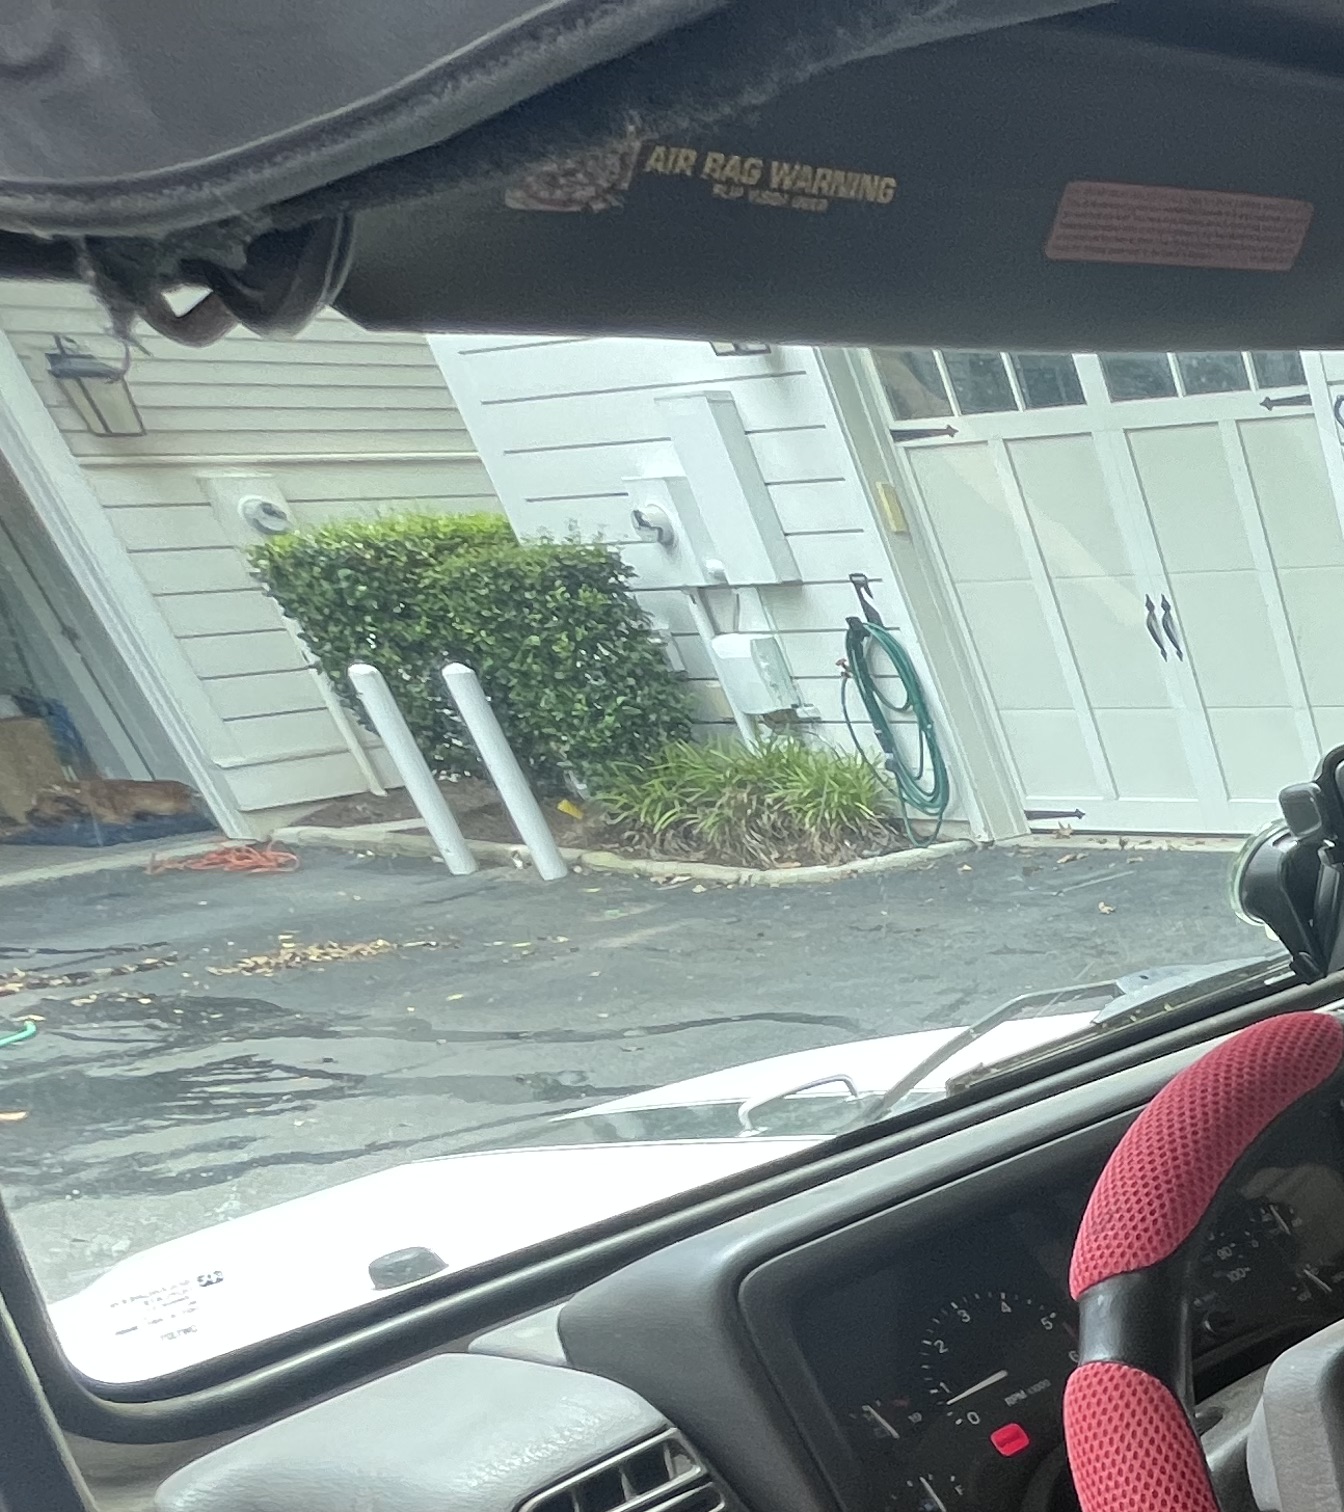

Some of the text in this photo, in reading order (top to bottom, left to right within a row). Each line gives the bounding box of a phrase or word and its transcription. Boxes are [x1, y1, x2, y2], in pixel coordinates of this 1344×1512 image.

[644, 146, 697, 176] AIR
[701, 151, 764, 185] BAG
[770, 160, 897, 204] WARNING
[1001, 1302, 1012, 1313] 4
[956, 1309, 971, 1323] 3
[1040, 1317, 1053, 1330] 5
[934, 1339, 949, 1354] 2
[966, 1411, 981, 1425] 0
